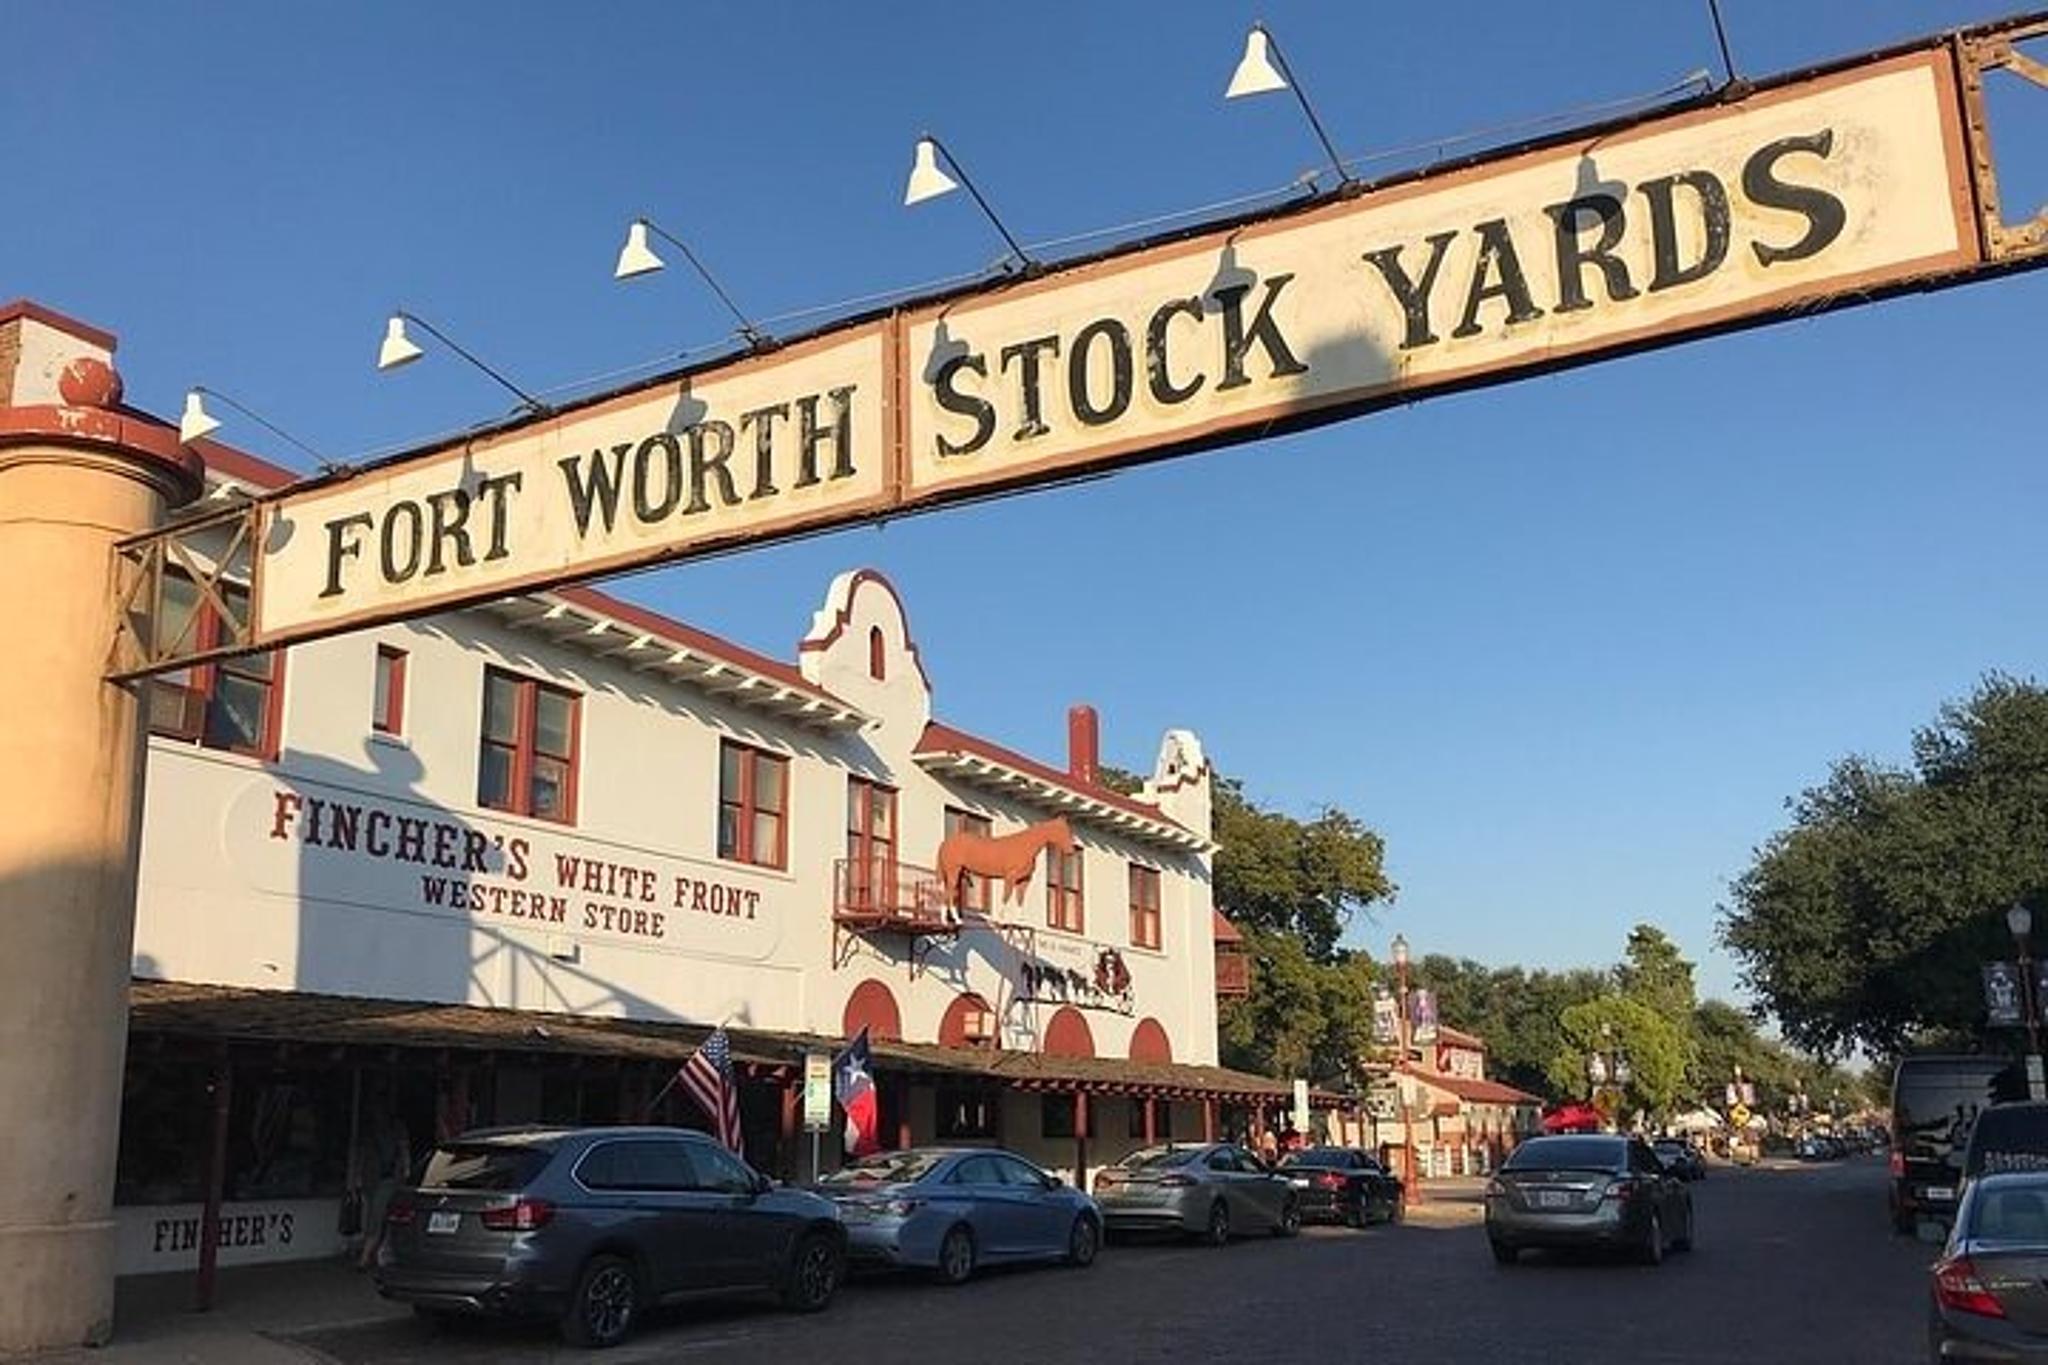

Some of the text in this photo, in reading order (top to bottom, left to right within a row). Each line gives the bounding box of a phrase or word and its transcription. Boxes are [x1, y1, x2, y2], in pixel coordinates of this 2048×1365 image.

[319, 128, 1847, 598] FORT WORTH STOCK YARDS
[270, 791, 760, 920] FINCHER'S WHITE FRONT
[421, 875, 665, 938] WESTERN STORE
[154, 1204, 294, 1252] FINHER'S
